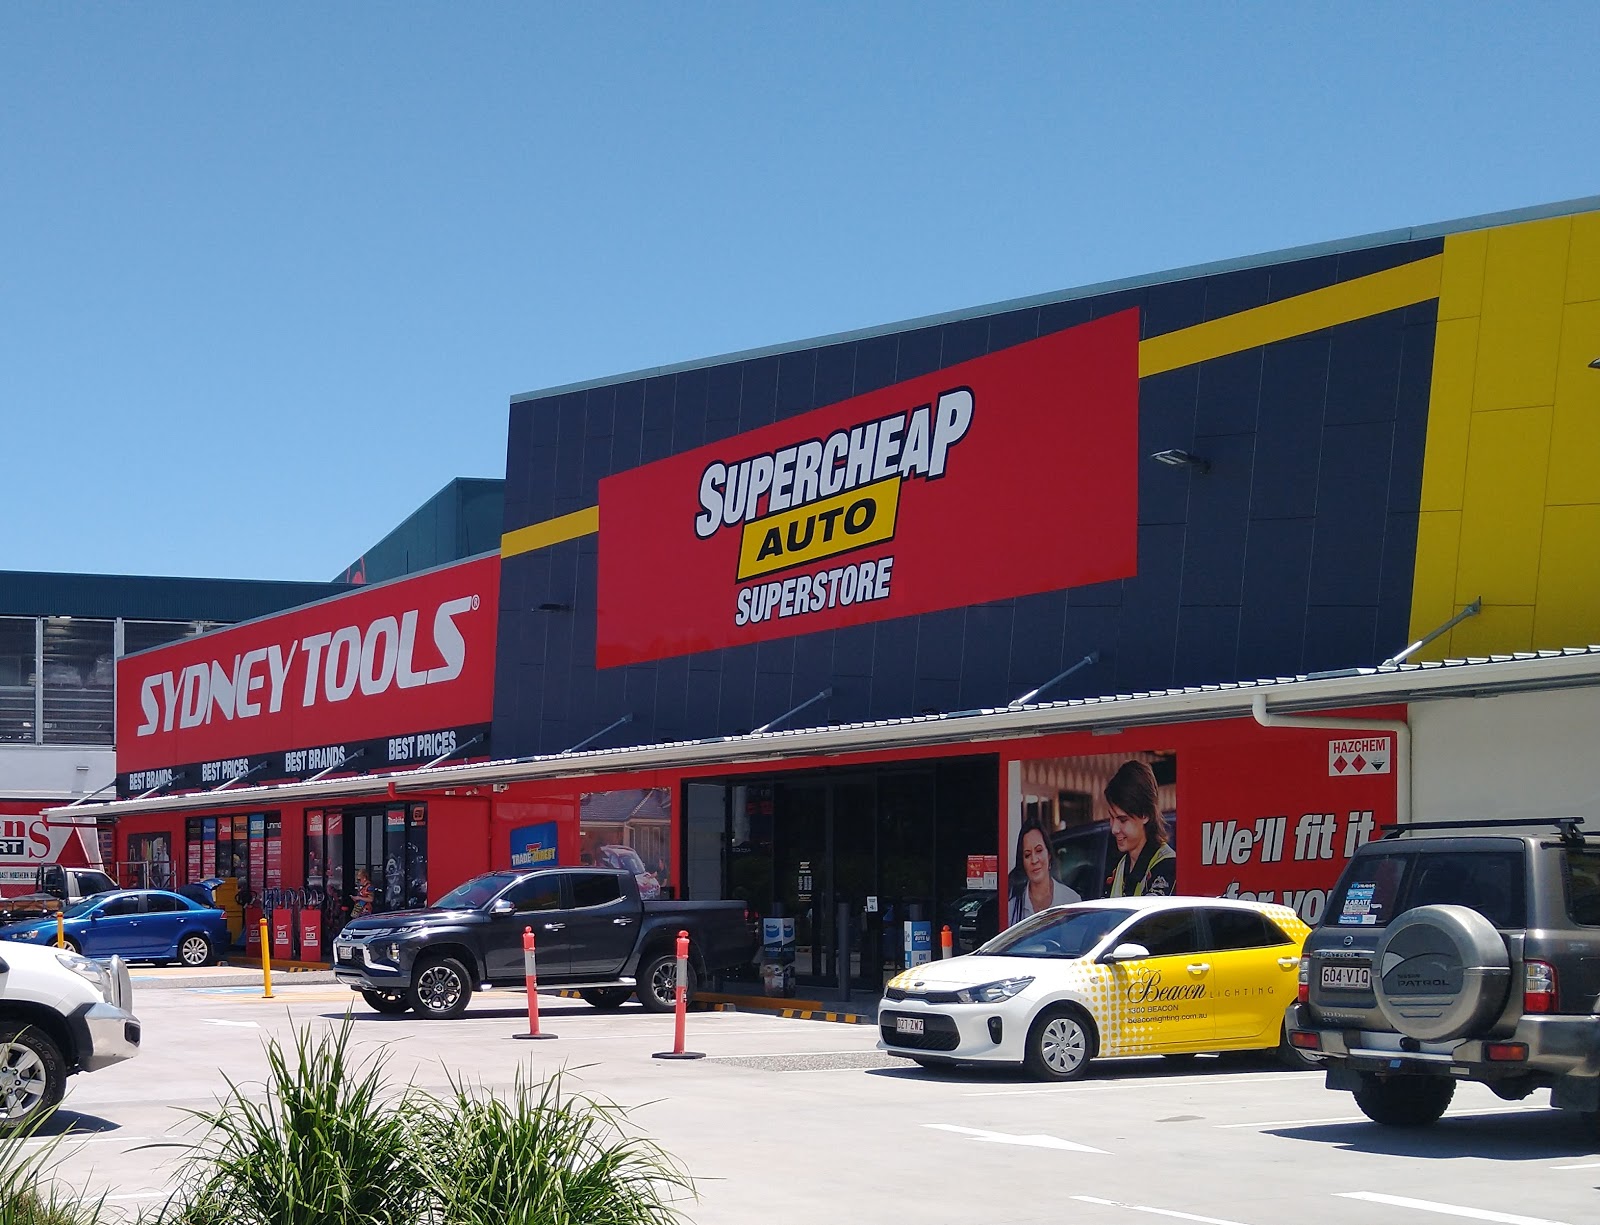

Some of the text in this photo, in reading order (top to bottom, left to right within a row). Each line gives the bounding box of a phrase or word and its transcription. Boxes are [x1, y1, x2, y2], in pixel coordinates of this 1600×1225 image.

[695, 388, 974, 538] SUPERCHEAP
[756, 498, 877, 562] AUTO
[735, 556, 894, 626] SUPERSTORE
[137, 595, 473, 737] SYDNEY TOOLS
[285, 746, 346, 772] BEST BRANDS
[389, 731, 457, 760] BEST PRICES
[1333, 739, 1386, 754] HAZCHEM
[129, 772, 146, 790] BEST
[202, 758, 249, 782] BEST PRICES
[1201, 810, 1376, 866] We'll fit it
[1127, 966, 1275, 1004] Beacon LIGHTING
[1147, 1004, 1179, 1013] BEACON
